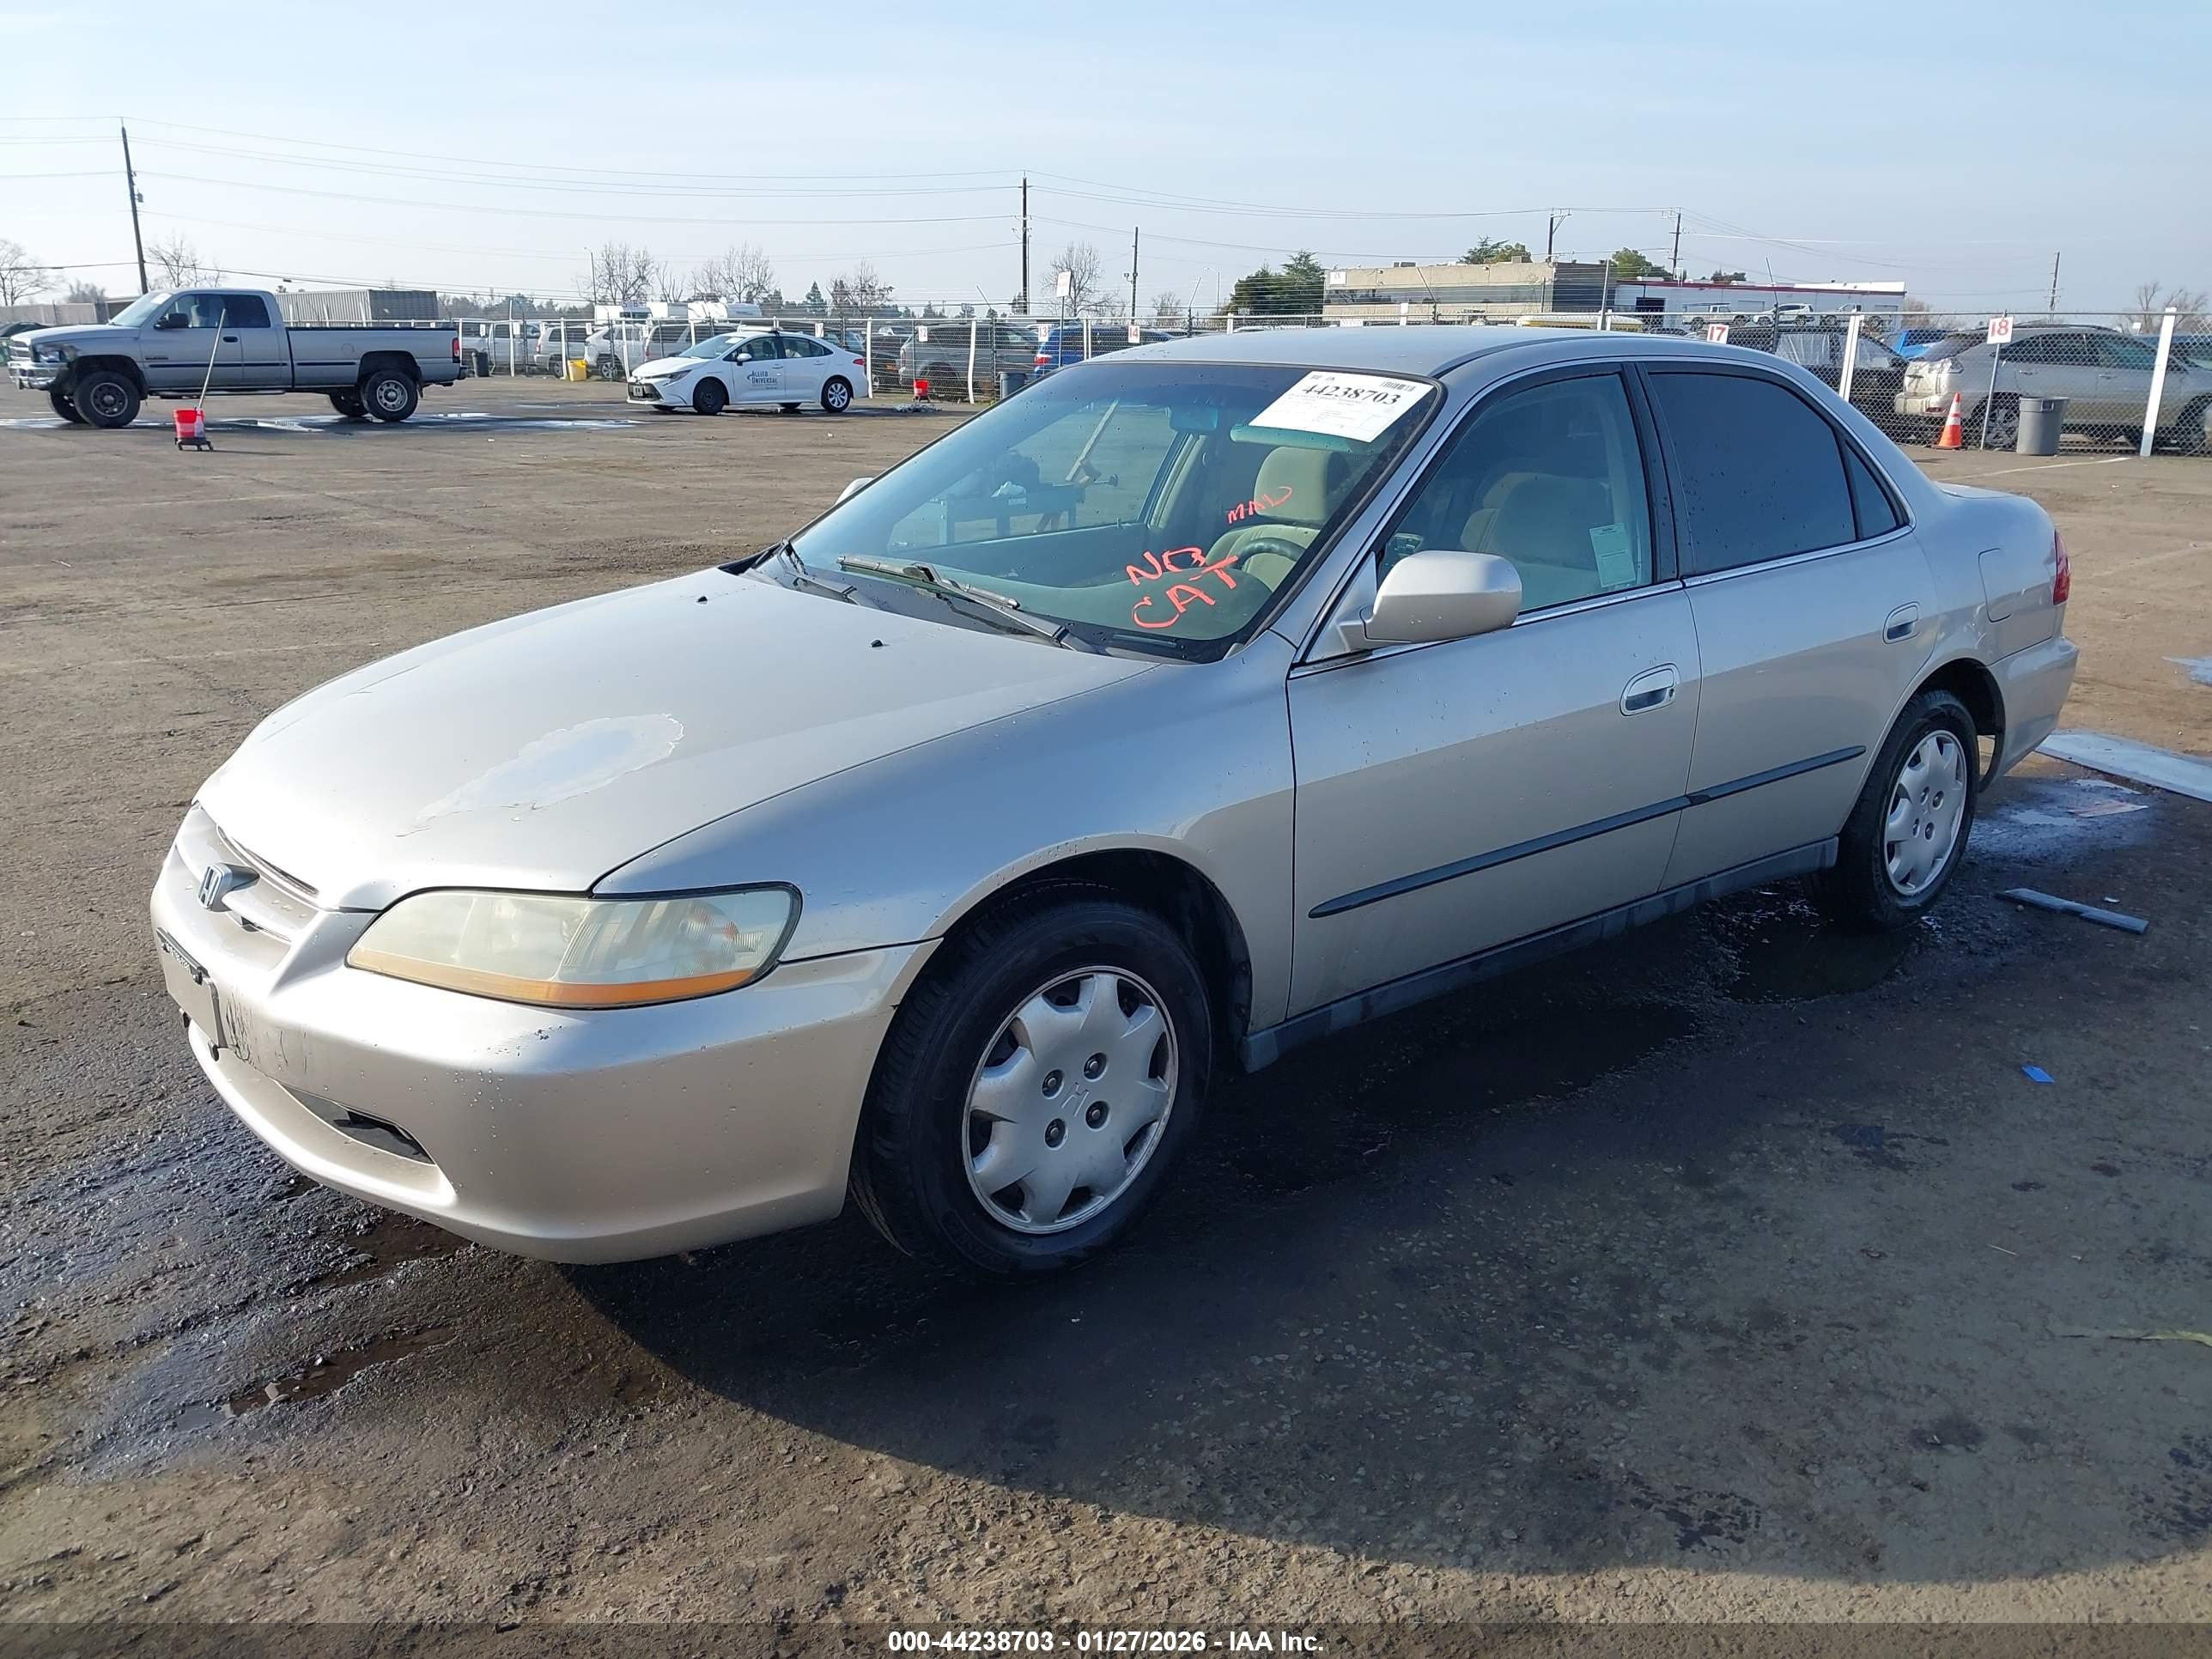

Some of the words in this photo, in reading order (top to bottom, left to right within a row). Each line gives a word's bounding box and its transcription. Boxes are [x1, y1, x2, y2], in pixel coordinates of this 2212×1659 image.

[1039, 326, 1048, 337] 13
[1129, 326, 1139, 338] 14
[1709, 326, 1727, 341] 17
[1990, 319, 2009, 337] 18
[1302, 384, 1401, 405] 44238703
[1132, 555, 1239, 629] CAT
